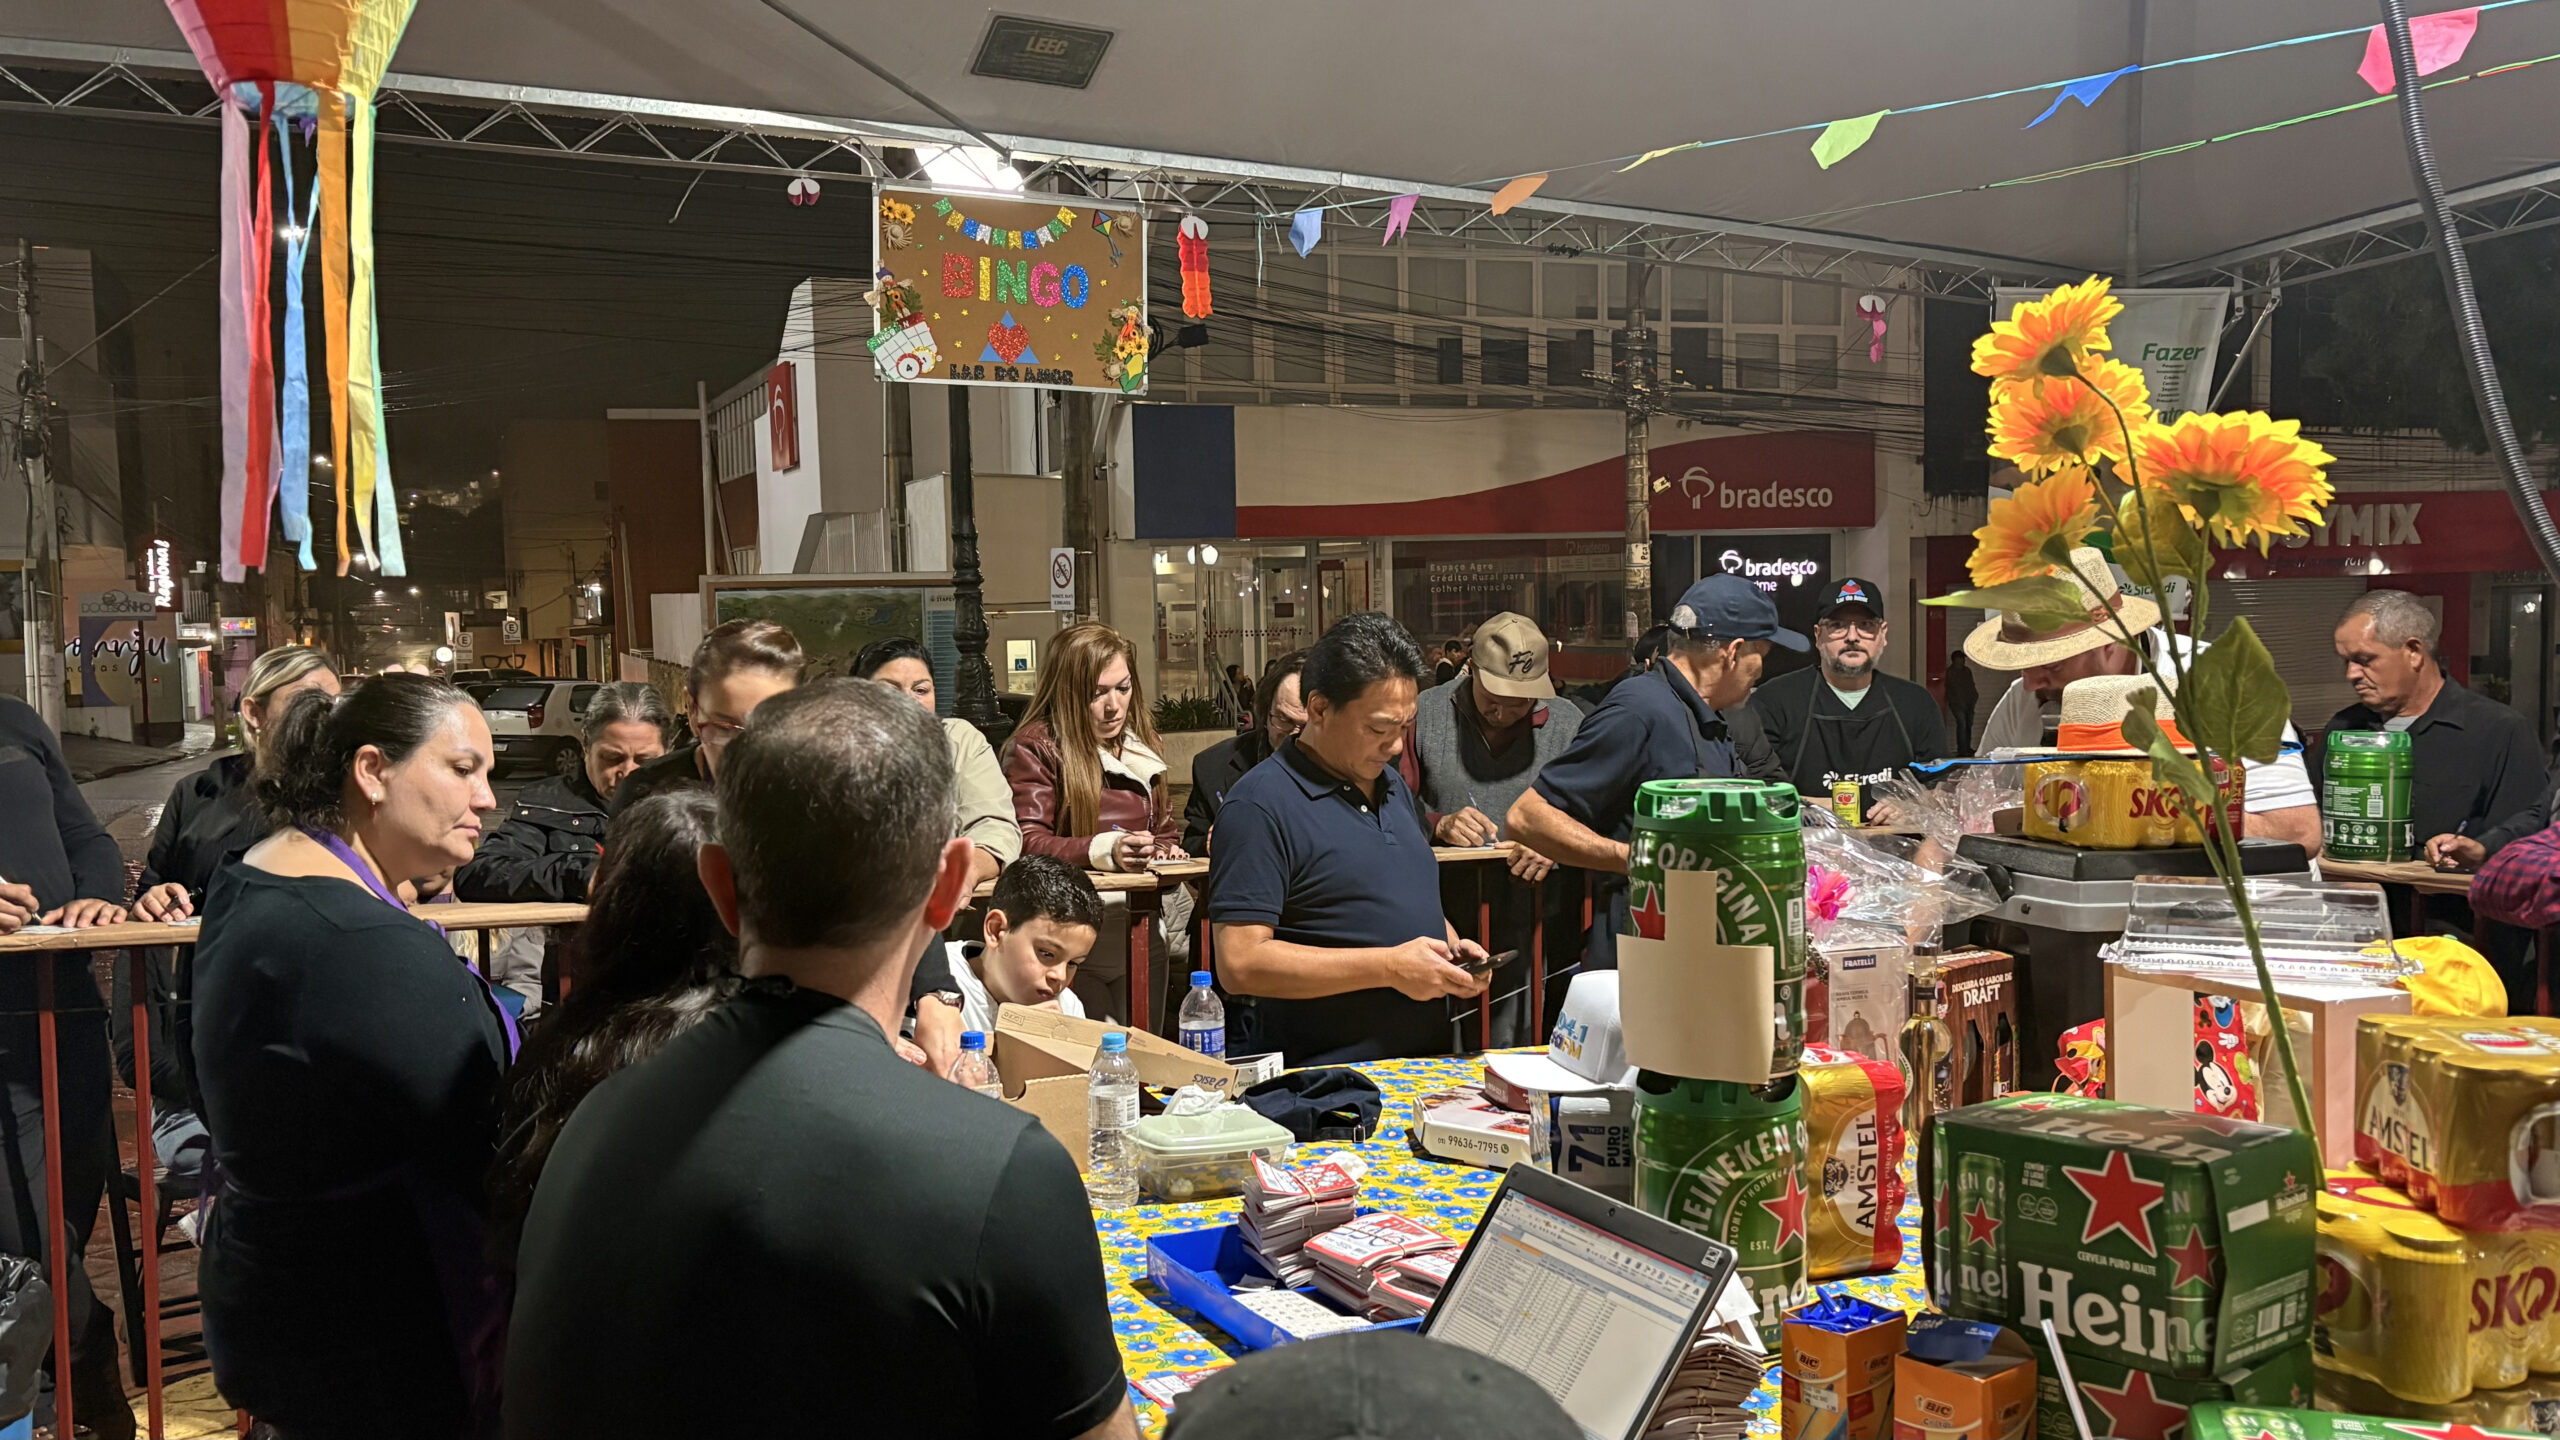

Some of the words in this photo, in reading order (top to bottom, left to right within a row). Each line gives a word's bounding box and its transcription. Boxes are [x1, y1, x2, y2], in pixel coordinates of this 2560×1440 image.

[1025, 35, 1069, 55] LEEC
[941, 252, 1089, 309] BINGO
[2142, 343, 2206, 361] Fazer
[1720, 481, 1833, 508] bradesco
[1430, 572, 1468, 583] Crédito
[1472, 573, 1499, 582] Rural
[1503, 573, 1525, 582] para
[1469, 562, 1493, 573] Agro
[1745, 558, 1817, 576] bradesco
[1430, 583, 1462, 593] colher
[1467, 582, 1513, 593] inovação
[1658, 842, 1768, 945] ORIGINA
[1844, 956, 1875, 969] FRATELLI
[1963, 984, 2001, 1007] DRAFT
[1192, 1073, 1217, 1086] asics
[1448, 1135, 1499, 1154] 99636-7795
[1568, 1124, 1605, 1172] 71
[1607, 1126, 1621, 1168] PURO
[1622, 1126, 1631, 1168] MALTE
[2369, 1105, 2433, 1173] AMSTEL
[1855, 1114, 1877, 1229] AMSTEL
[1750, 1240, 1770, 1251] EST.
[2077, 1251, 2107, 1266] CERVEJA
[2109, 1256, 2130, 1271] PURO
[2132, 1260, 2156, 1277] MALTE
